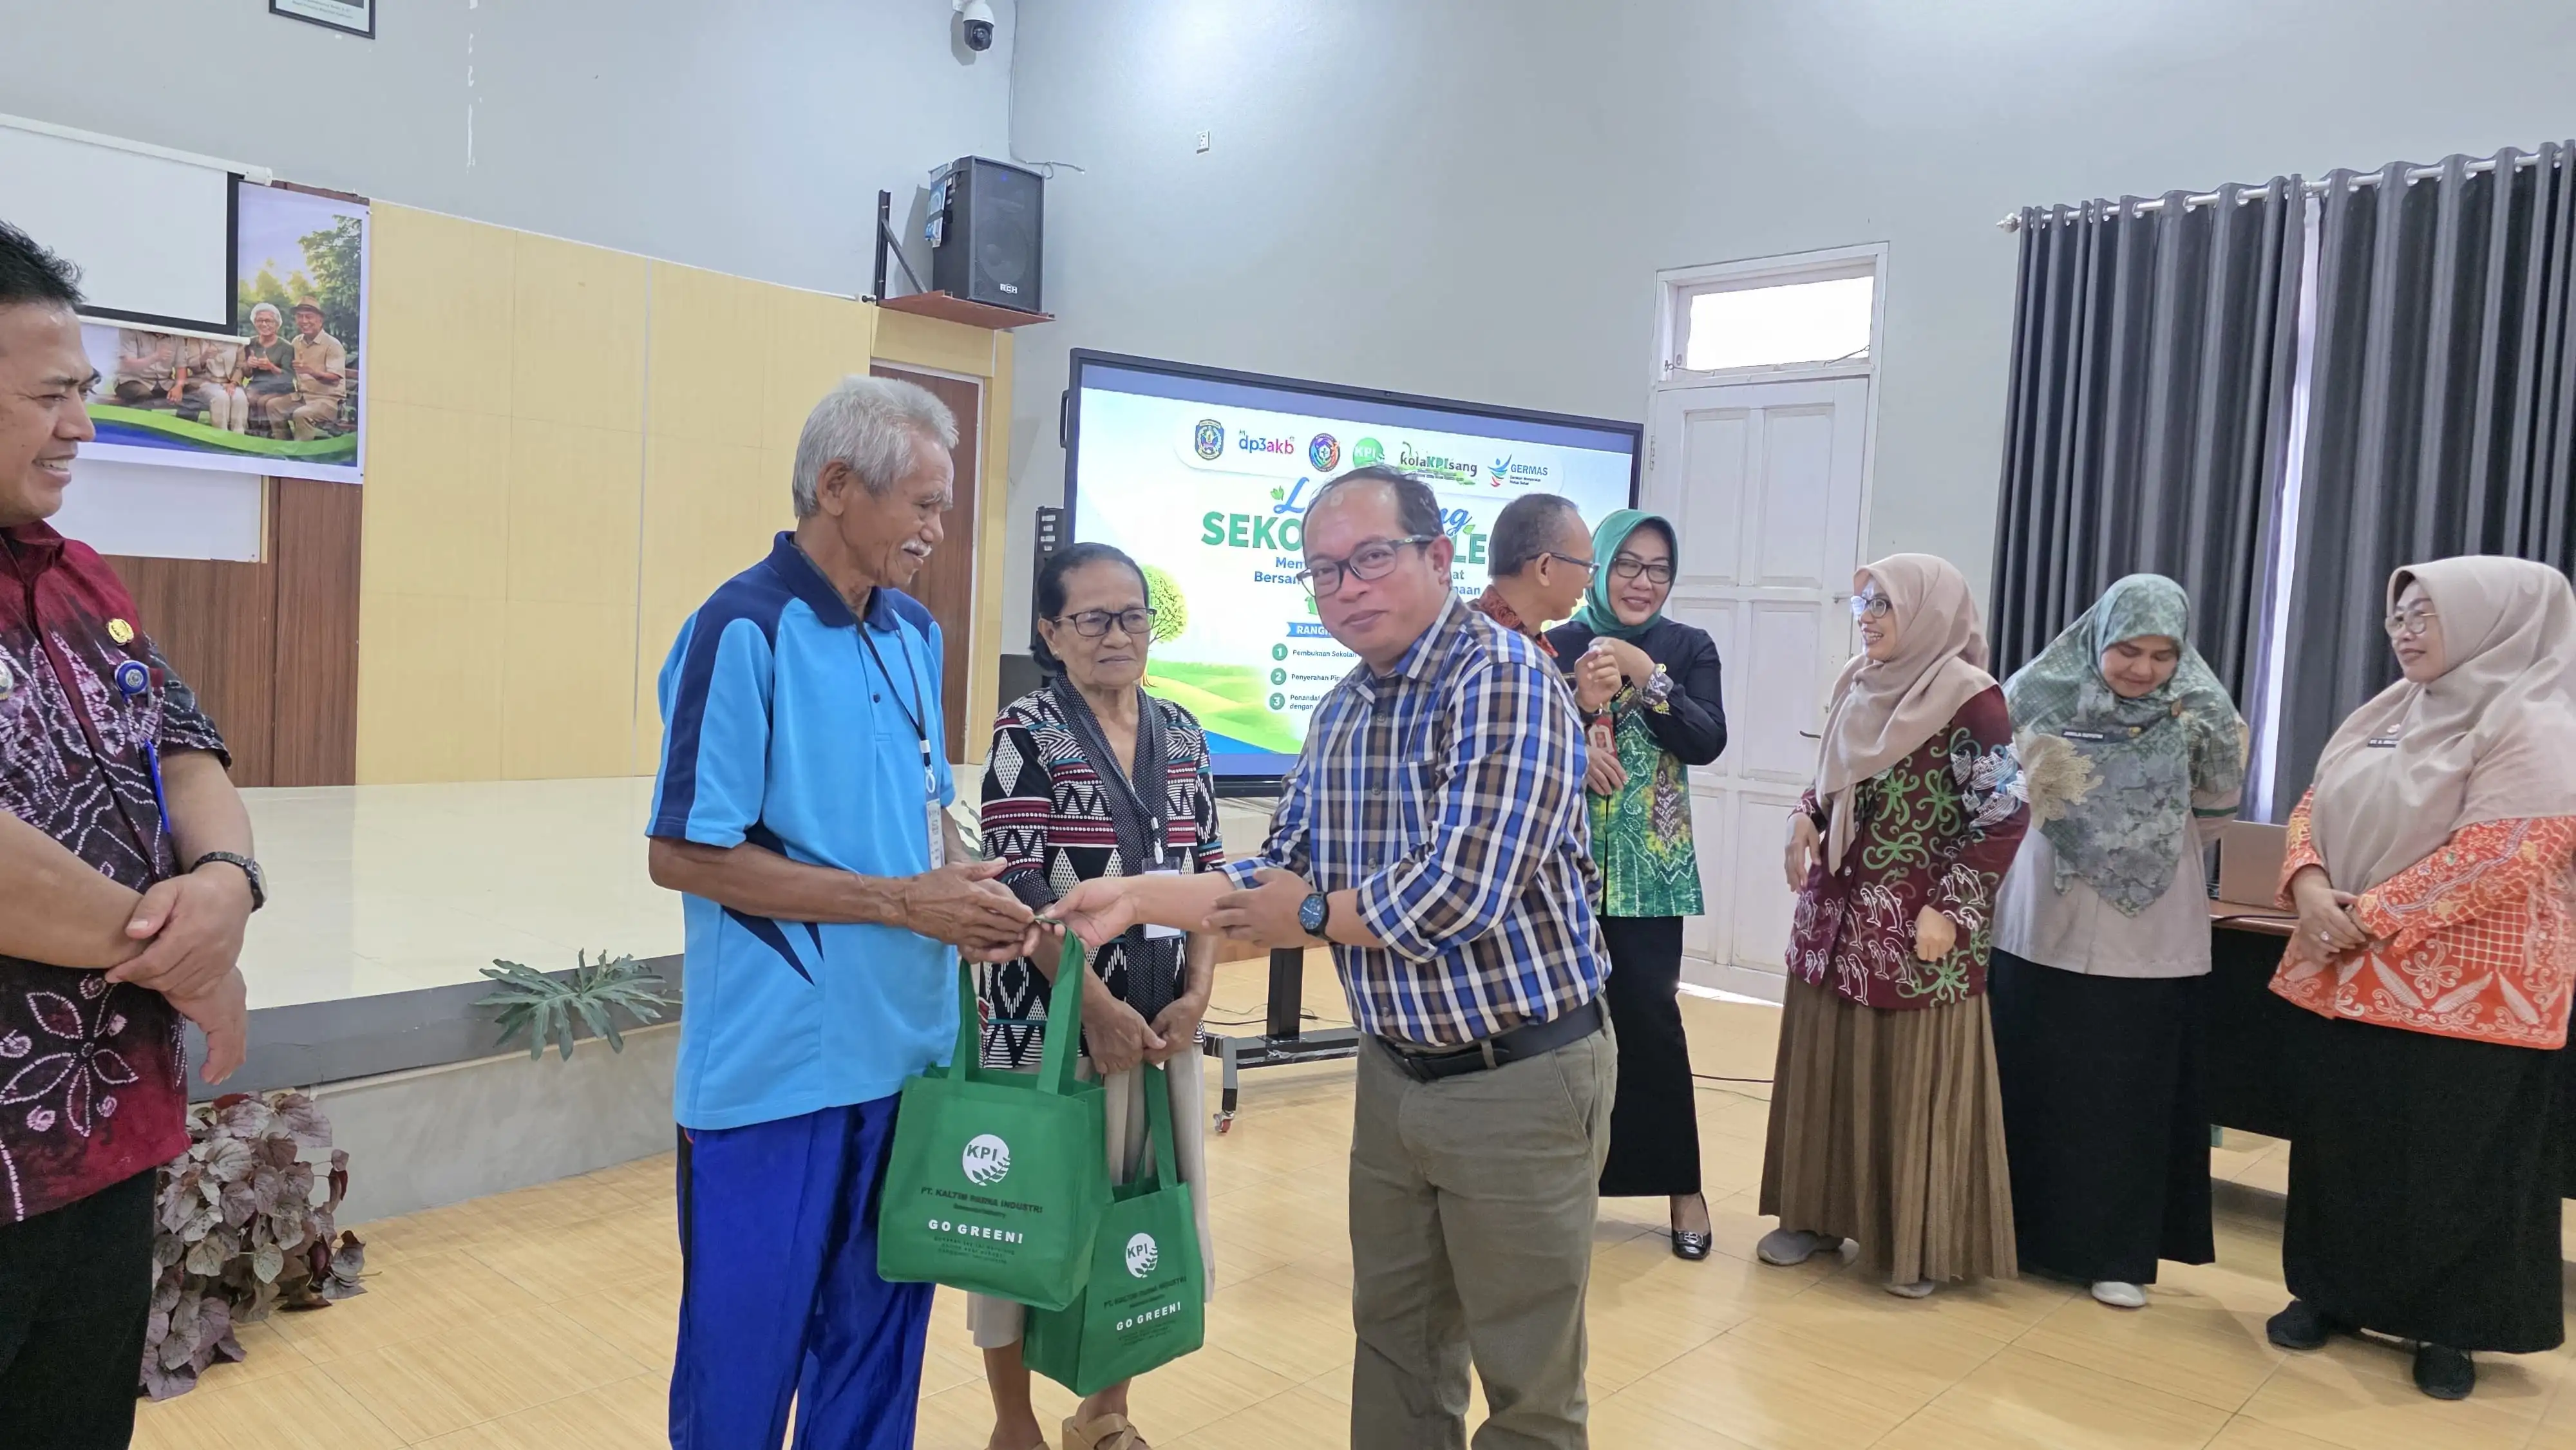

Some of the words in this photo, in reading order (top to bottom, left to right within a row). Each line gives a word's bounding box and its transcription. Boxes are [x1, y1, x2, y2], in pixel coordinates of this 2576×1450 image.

[1239, 435, 1294, 455] dp3akb
[1354, 446, 1377, 460] KPI
[1400, 451, 1477, 477] kolaKPIsang
[1511, 464, 1548, 476] GERMAS
[1201, 511, 1303, 551] SEKO
[1452, 533, 1487, 565] LE
[1452, 569, 1464, 580] at
[1297, 625, 1327, 636] RANG
[1277, 648, 1282, 657] 1
[1293, 649, 1331, 657] Pembukaan
[1275, 672, 1282, 681] 2
[1273, 697, 1280, 706] 3
[967, 1144, 998, 1161] KPI
[921, 1187, 933, 1196] PT.
[1000, 1200, 1043, 1214] INDUSTRI
[928, 1219, 951, 1232] GO
[1128, 1243, 1148, 1259] KPI
[1116, 1319, 1133, 1331] GO
